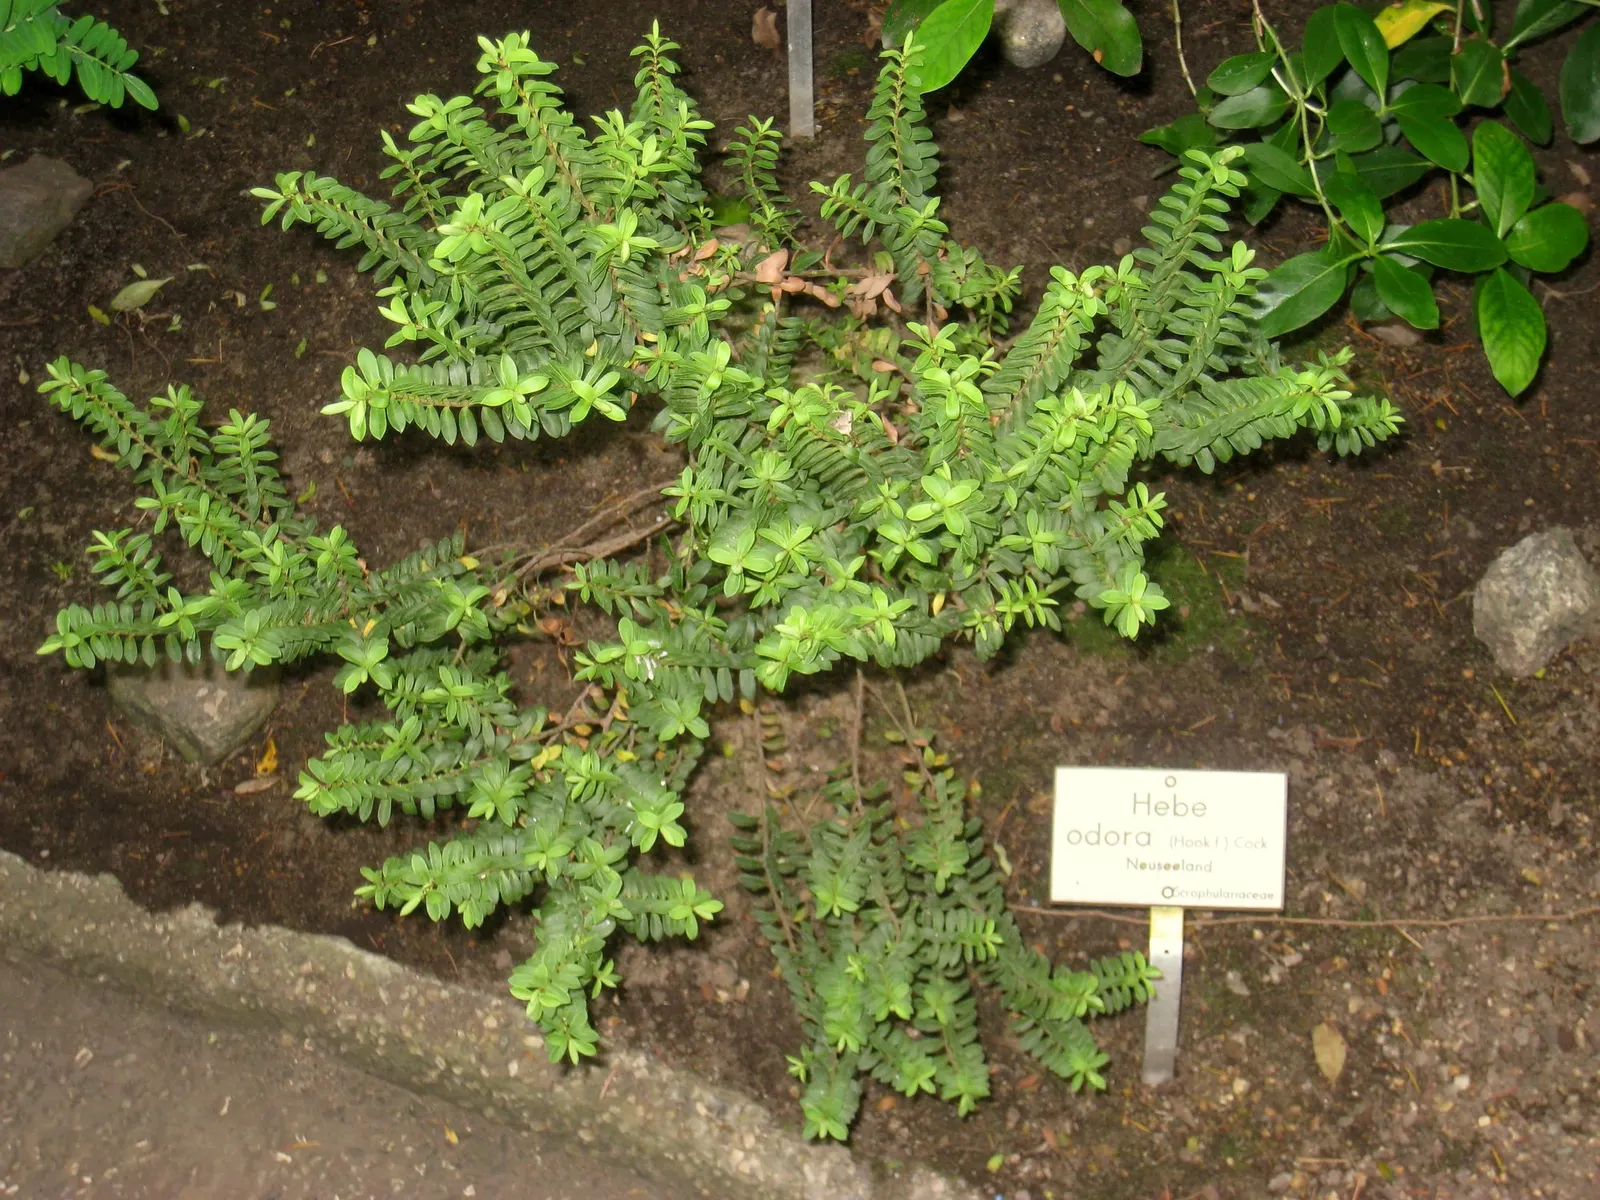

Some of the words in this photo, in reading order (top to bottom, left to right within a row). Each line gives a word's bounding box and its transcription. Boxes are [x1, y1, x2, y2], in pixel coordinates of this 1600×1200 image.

[1132, 792, 1208, 817] Hebe
[1066, 822, 1152, 847] odora
[1126, 857, 1213, 873] Neuseeland
